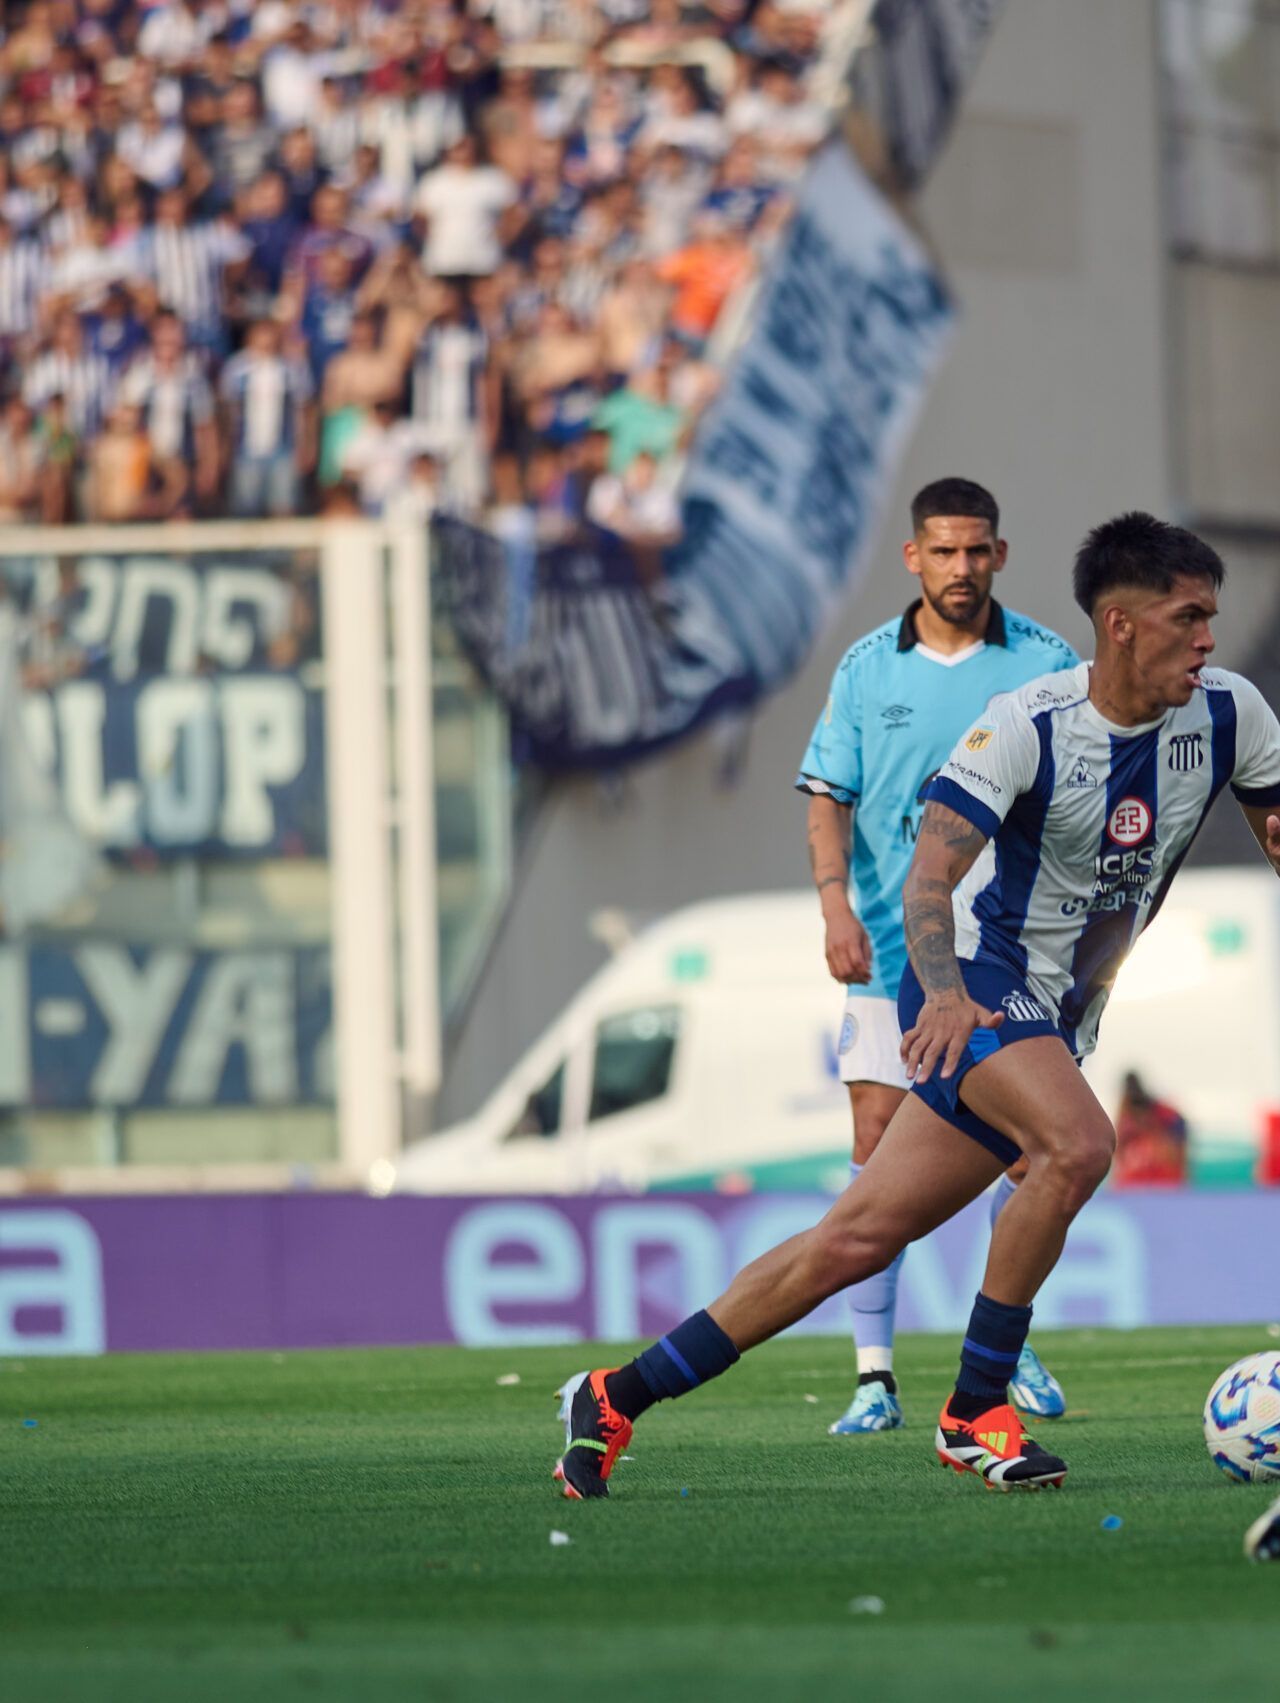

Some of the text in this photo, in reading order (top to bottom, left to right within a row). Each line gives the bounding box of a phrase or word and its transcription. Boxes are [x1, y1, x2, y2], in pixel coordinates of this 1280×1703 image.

[1009, 621, 1074, 657] SANOS
[1094, 846, 1155, 876] ICBC
[1093, 871, 1152, 895] Arntina
